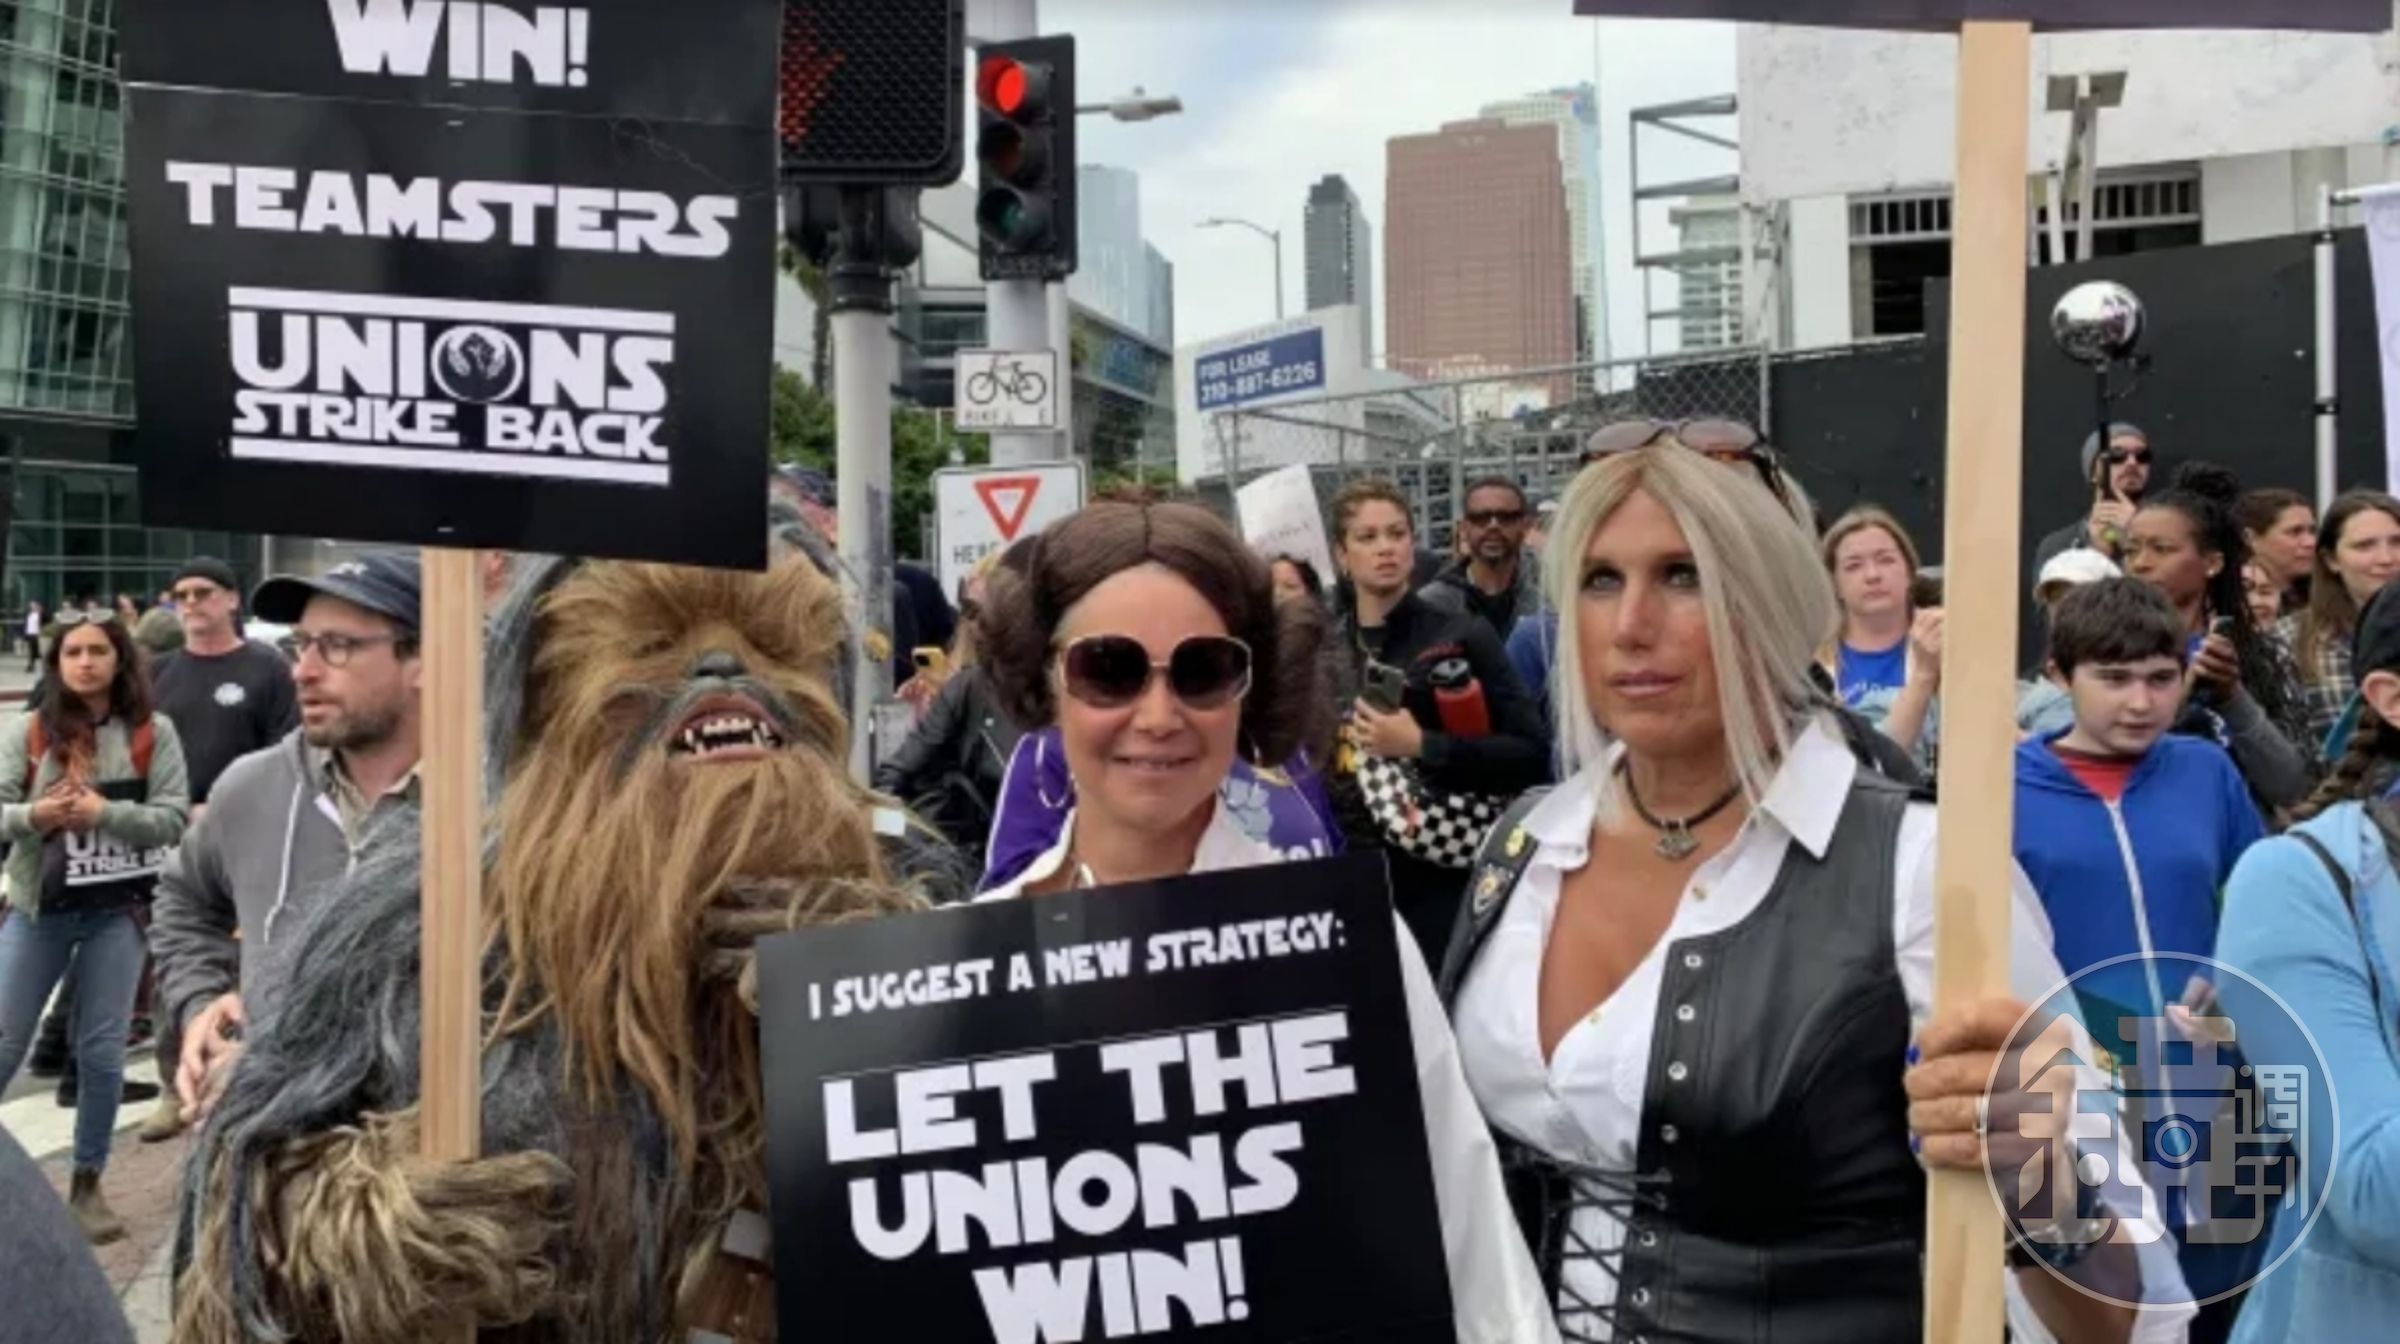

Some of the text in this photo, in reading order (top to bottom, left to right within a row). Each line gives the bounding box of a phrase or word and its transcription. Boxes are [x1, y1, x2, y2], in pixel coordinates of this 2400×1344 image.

[328, 0, 590, 87] WIN!
[166, 161, 738, 258] TEAMSTERS
[230, 311, 675, 412] UNIONS
[1229, 348, 1272, 375] LEASE
[232, 390, 669, 461] STRIKE BACK
[809, 912, 1348, 1021] I SUGGEST A NEW STRATEGY:
[822, 1013, 1356, 1163] LET THE
[849, 1122, 1303, 1260] UNIONS
[972, 1237, 1249, 1344] WIN!
